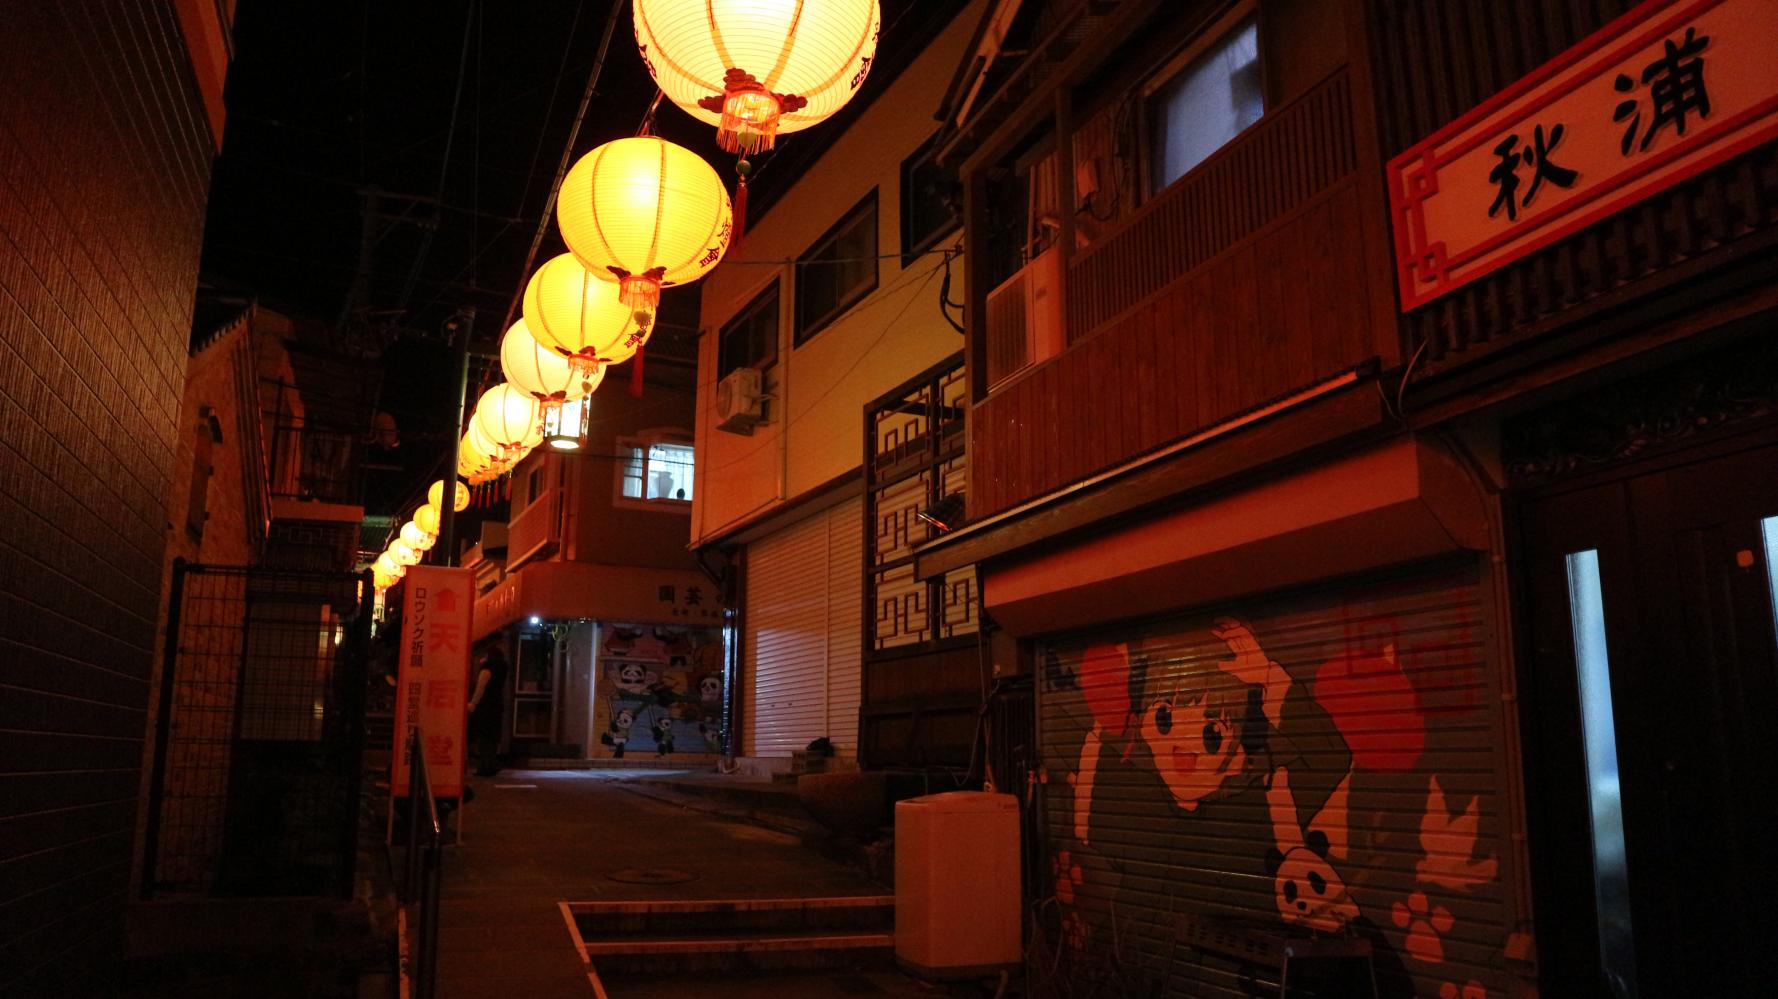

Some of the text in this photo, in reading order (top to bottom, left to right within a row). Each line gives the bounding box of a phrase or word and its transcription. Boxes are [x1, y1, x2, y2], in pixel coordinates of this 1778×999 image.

[1489, 28, 1710, 220] 秋浦
[410, 587, 425, 668] ロウソク祈願
[426, 622, 460, 767] 天后堂
